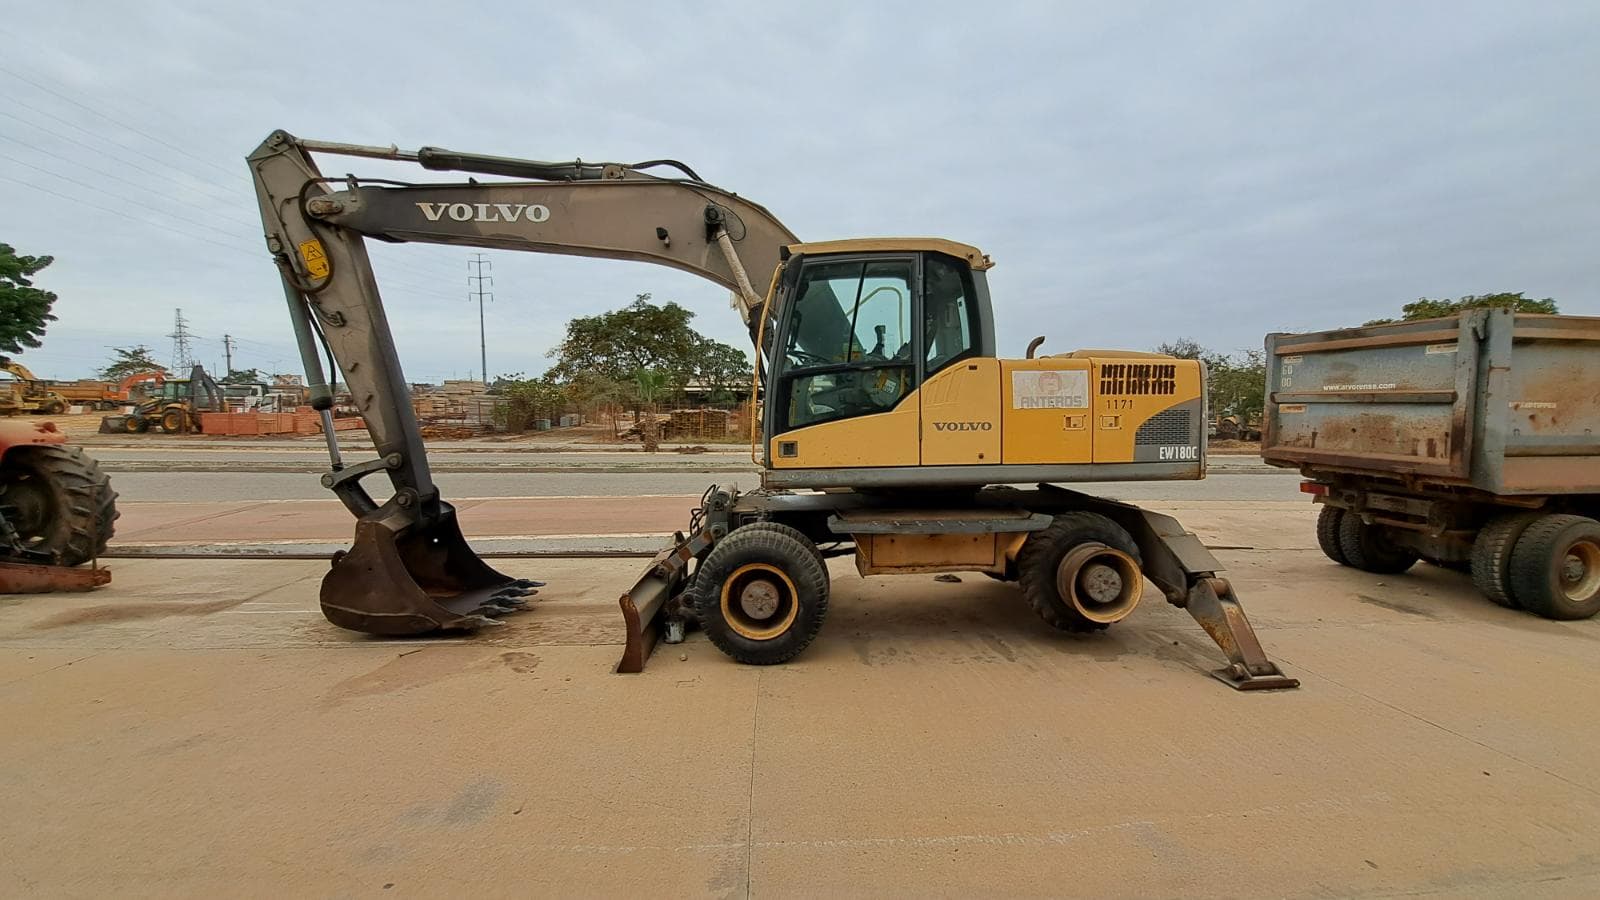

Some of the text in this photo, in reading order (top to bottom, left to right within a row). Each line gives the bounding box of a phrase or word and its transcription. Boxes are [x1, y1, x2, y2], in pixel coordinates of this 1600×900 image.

[416, 202, 551, 222] VOLVO
[1020, 396, 1083, 407] ANTEROS
[1106, 399, 1133, 410] 1171
[932, 422, 993, 431] VOLVO
[1159, 446, 1198, 460] EW180C
